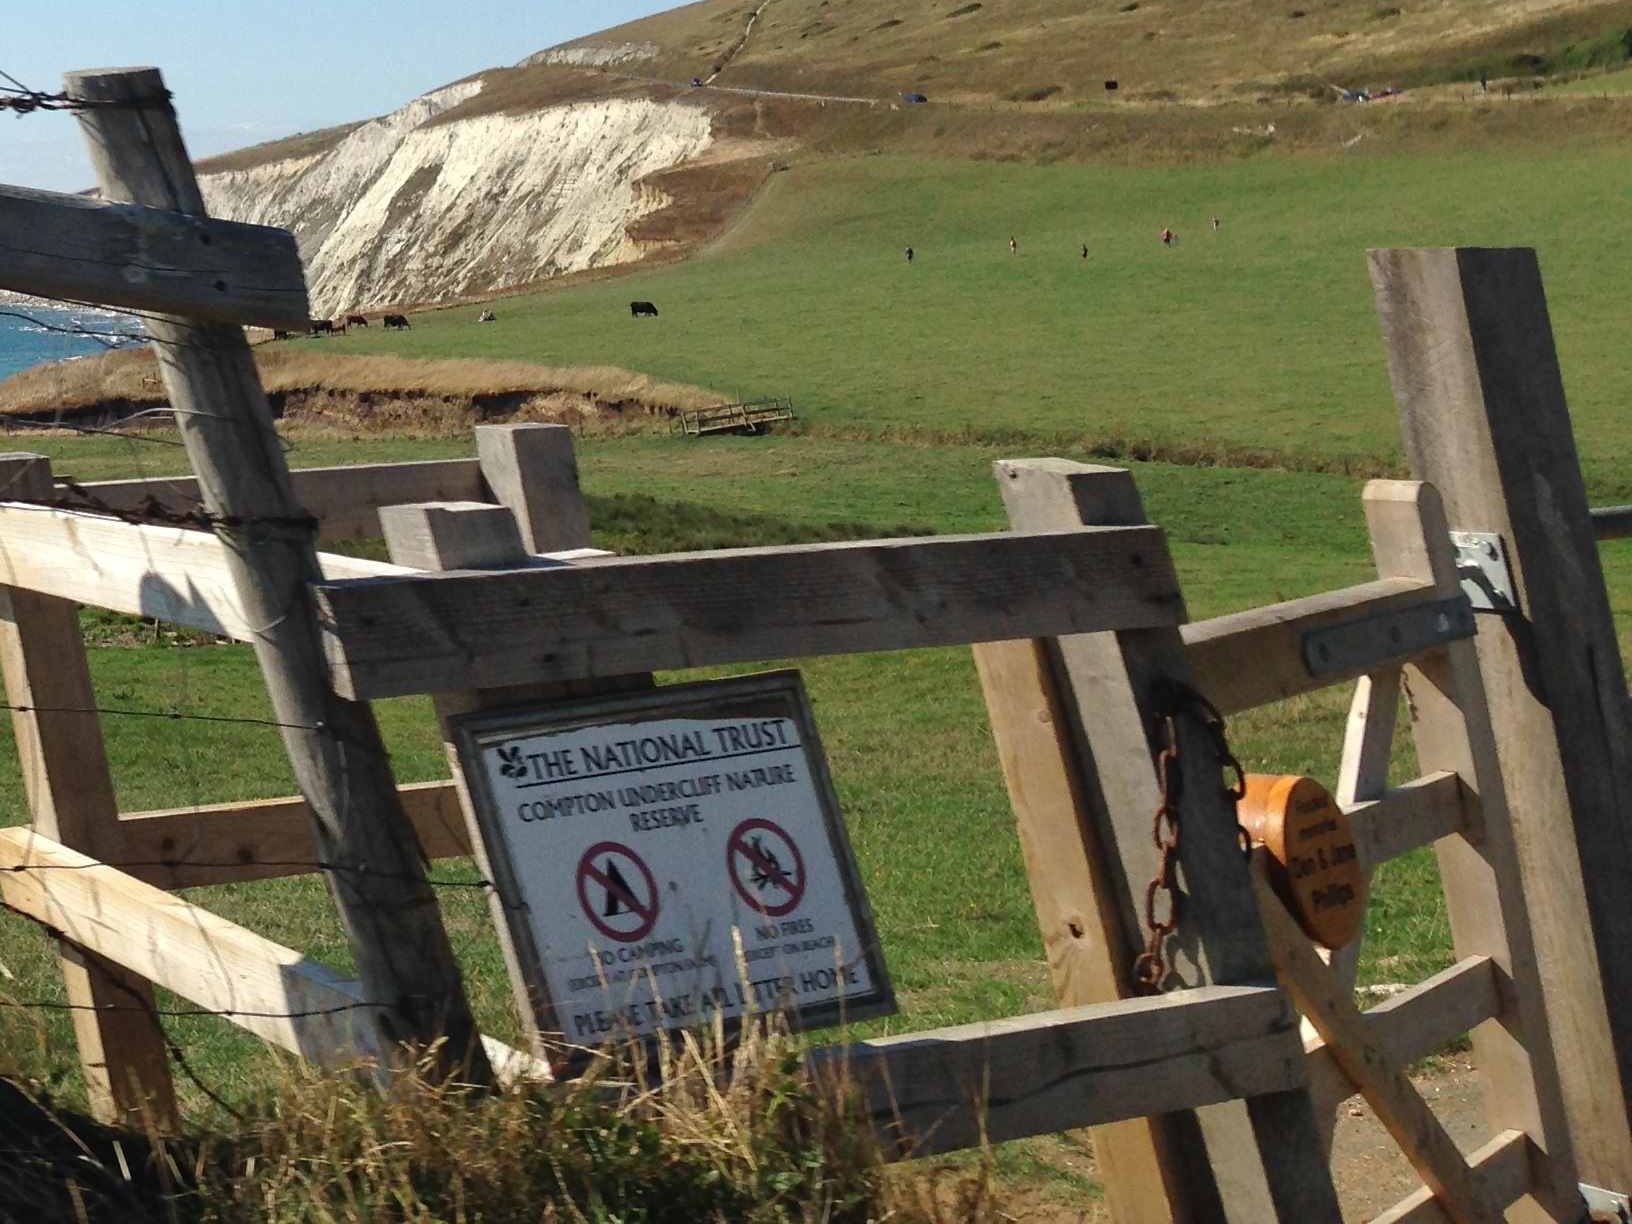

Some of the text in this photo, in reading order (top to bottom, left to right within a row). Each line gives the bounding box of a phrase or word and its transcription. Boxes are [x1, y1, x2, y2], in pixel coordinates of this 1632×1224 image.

[527, 719, 788, 780] THE NATIONAL TRUST
[518, 764, 798, 823] COMPTON UNDERCLIFF NATURE
[629, 804, 704, 832] RESERVE
[755, 917, 815, 942] NO FIRES
[589, 937, 685, 967] O CAMPING
[734, 977, 799, 1005] LTTER
